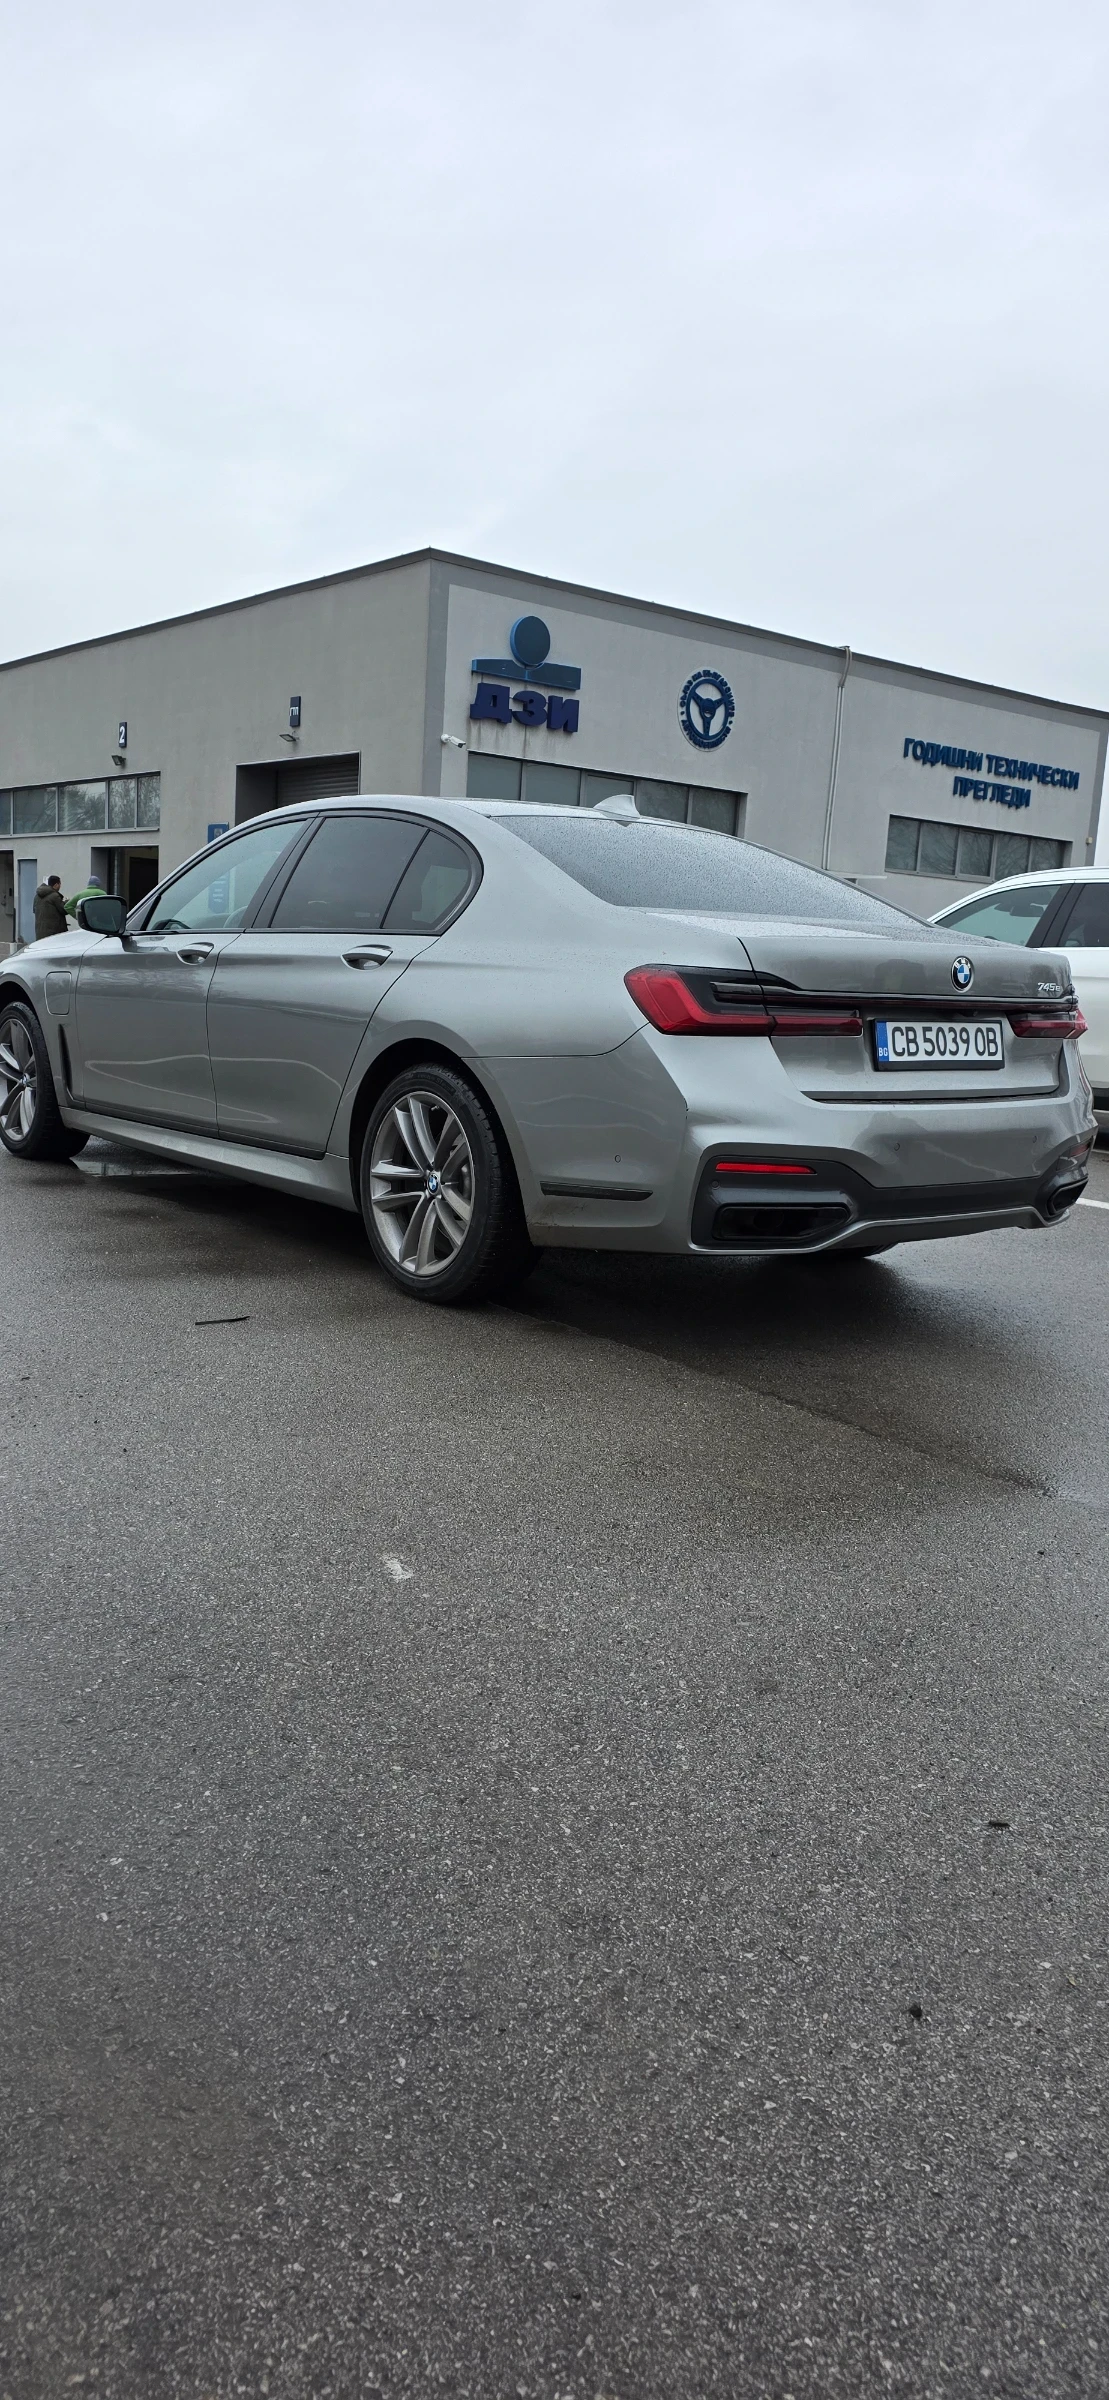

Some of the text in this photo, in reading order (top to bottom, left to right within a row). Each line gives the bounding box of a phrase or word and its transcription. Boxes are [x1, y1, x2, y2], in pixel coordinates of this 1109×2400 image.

[470, 683, 580, 733] ДЗИ
[119, 726, 125, 743] 2
[903, 738, 1080, 790] ГОДИШНИ ТЕХНИЧЕСКИ
[953, 776, 1031, 809] ПРЕГЛЕДИ
[878, 1047, 888, 1057] BG
[892, 1026, 919, 1056] CB
[922, 1026, 970, 1056] 5039
